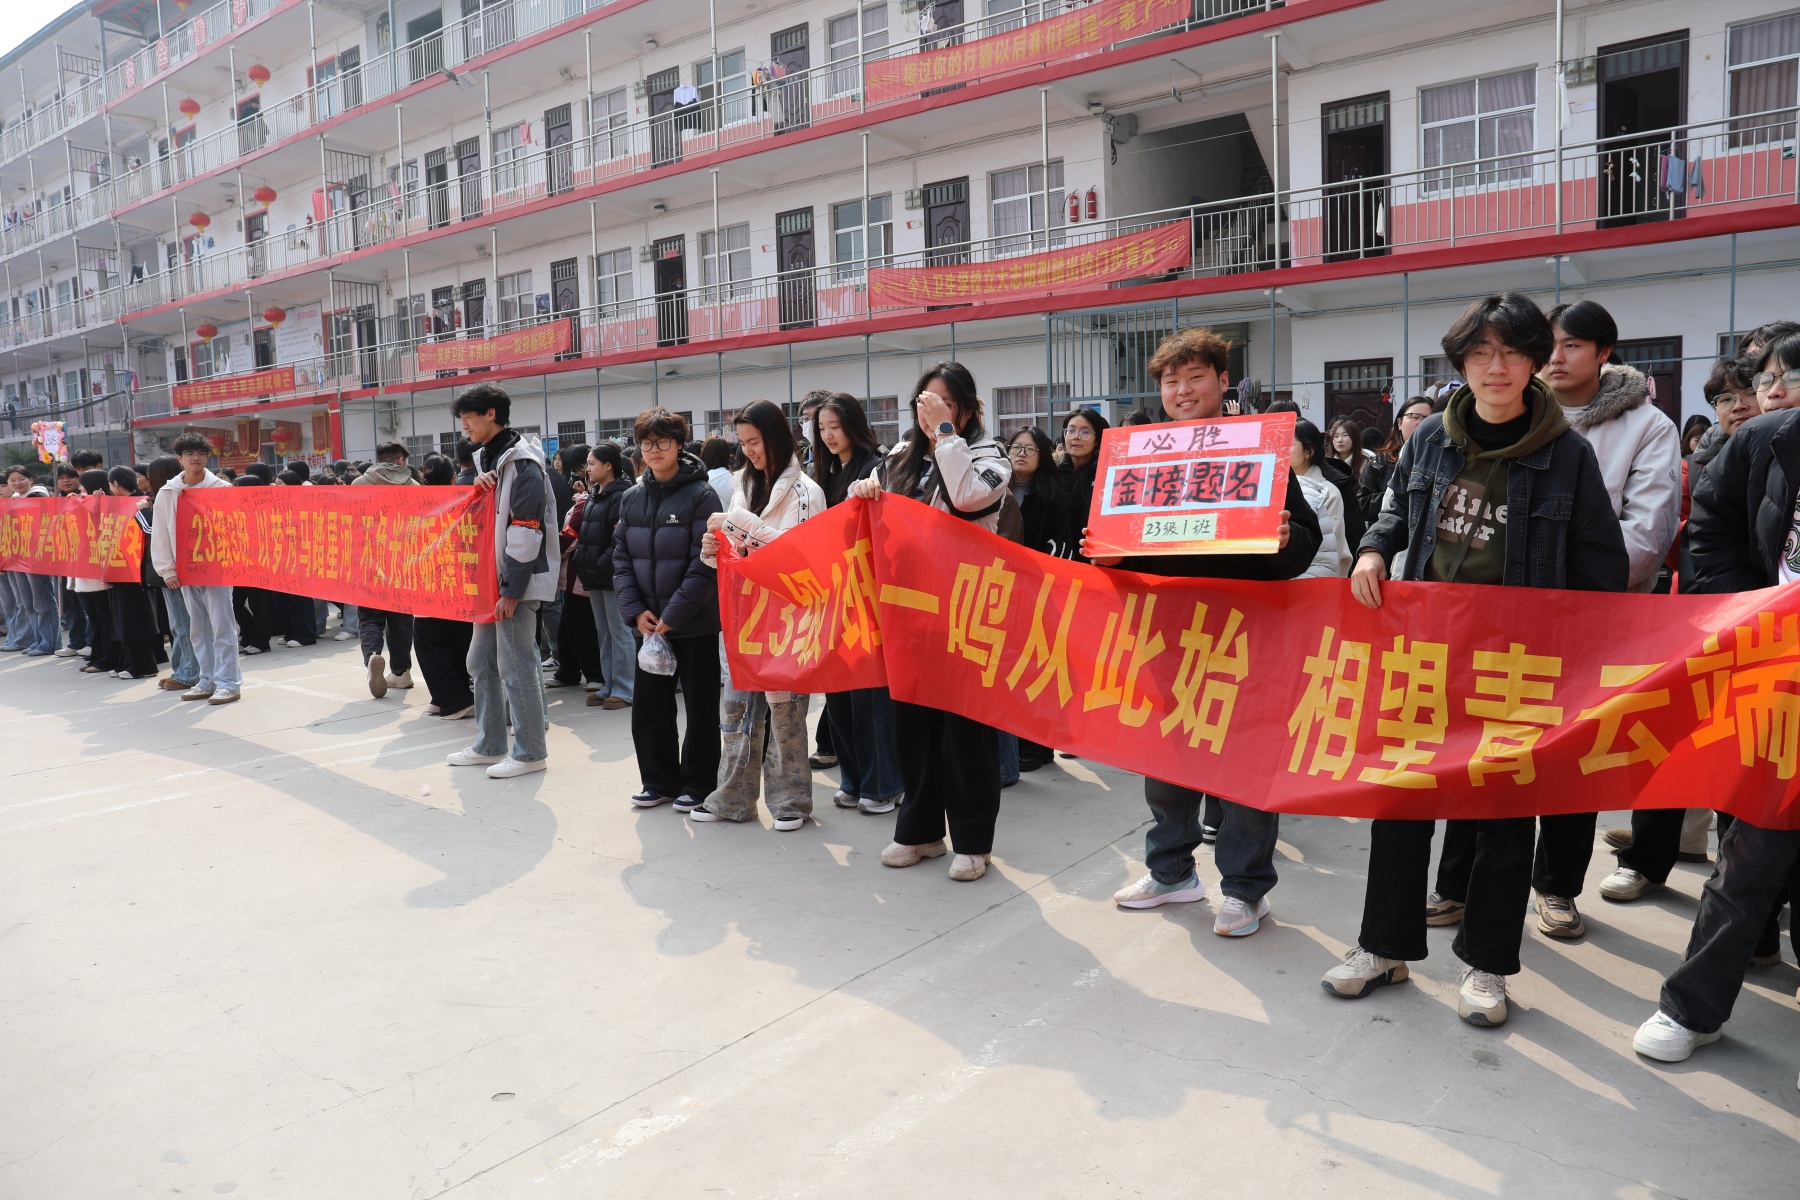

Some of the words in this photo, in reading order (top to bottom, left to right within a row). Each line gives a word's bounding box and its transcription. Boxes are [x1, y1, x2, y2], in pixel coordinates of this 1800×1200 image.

[1143, 426, 1229, 455] 必胜
[1113, 461, 1258, 507] 金榜题名
[1145, 519, 1211, 537] 23级1班
[1287, 610, 1800, 790] 相望青云端
